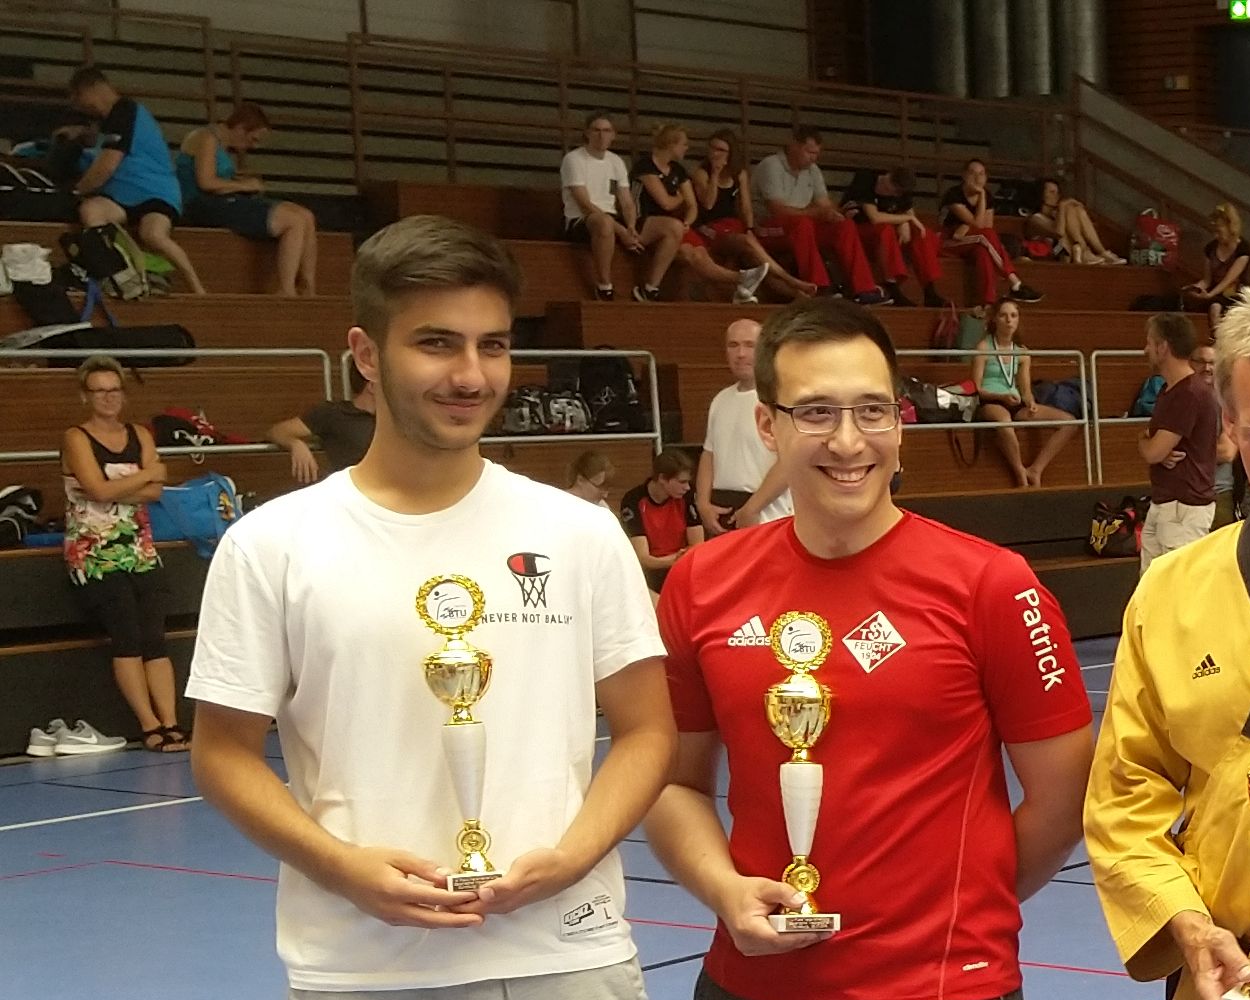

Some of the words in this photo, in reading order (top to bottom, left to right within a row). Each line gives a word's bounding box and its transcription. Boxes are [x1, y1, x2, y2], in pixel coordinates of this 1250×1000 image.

[481, 612, 518, 625] NEVER
[521, 612, 541, 624] NOT
[860, 621, 893, 642] TSV
[728, 634, 772, 647] adidas
[854, 641, 892, 653] FEUCHT
[1015, 588, 1066, 693] Patrick
[1192, 666, 1221, 680] adidas
